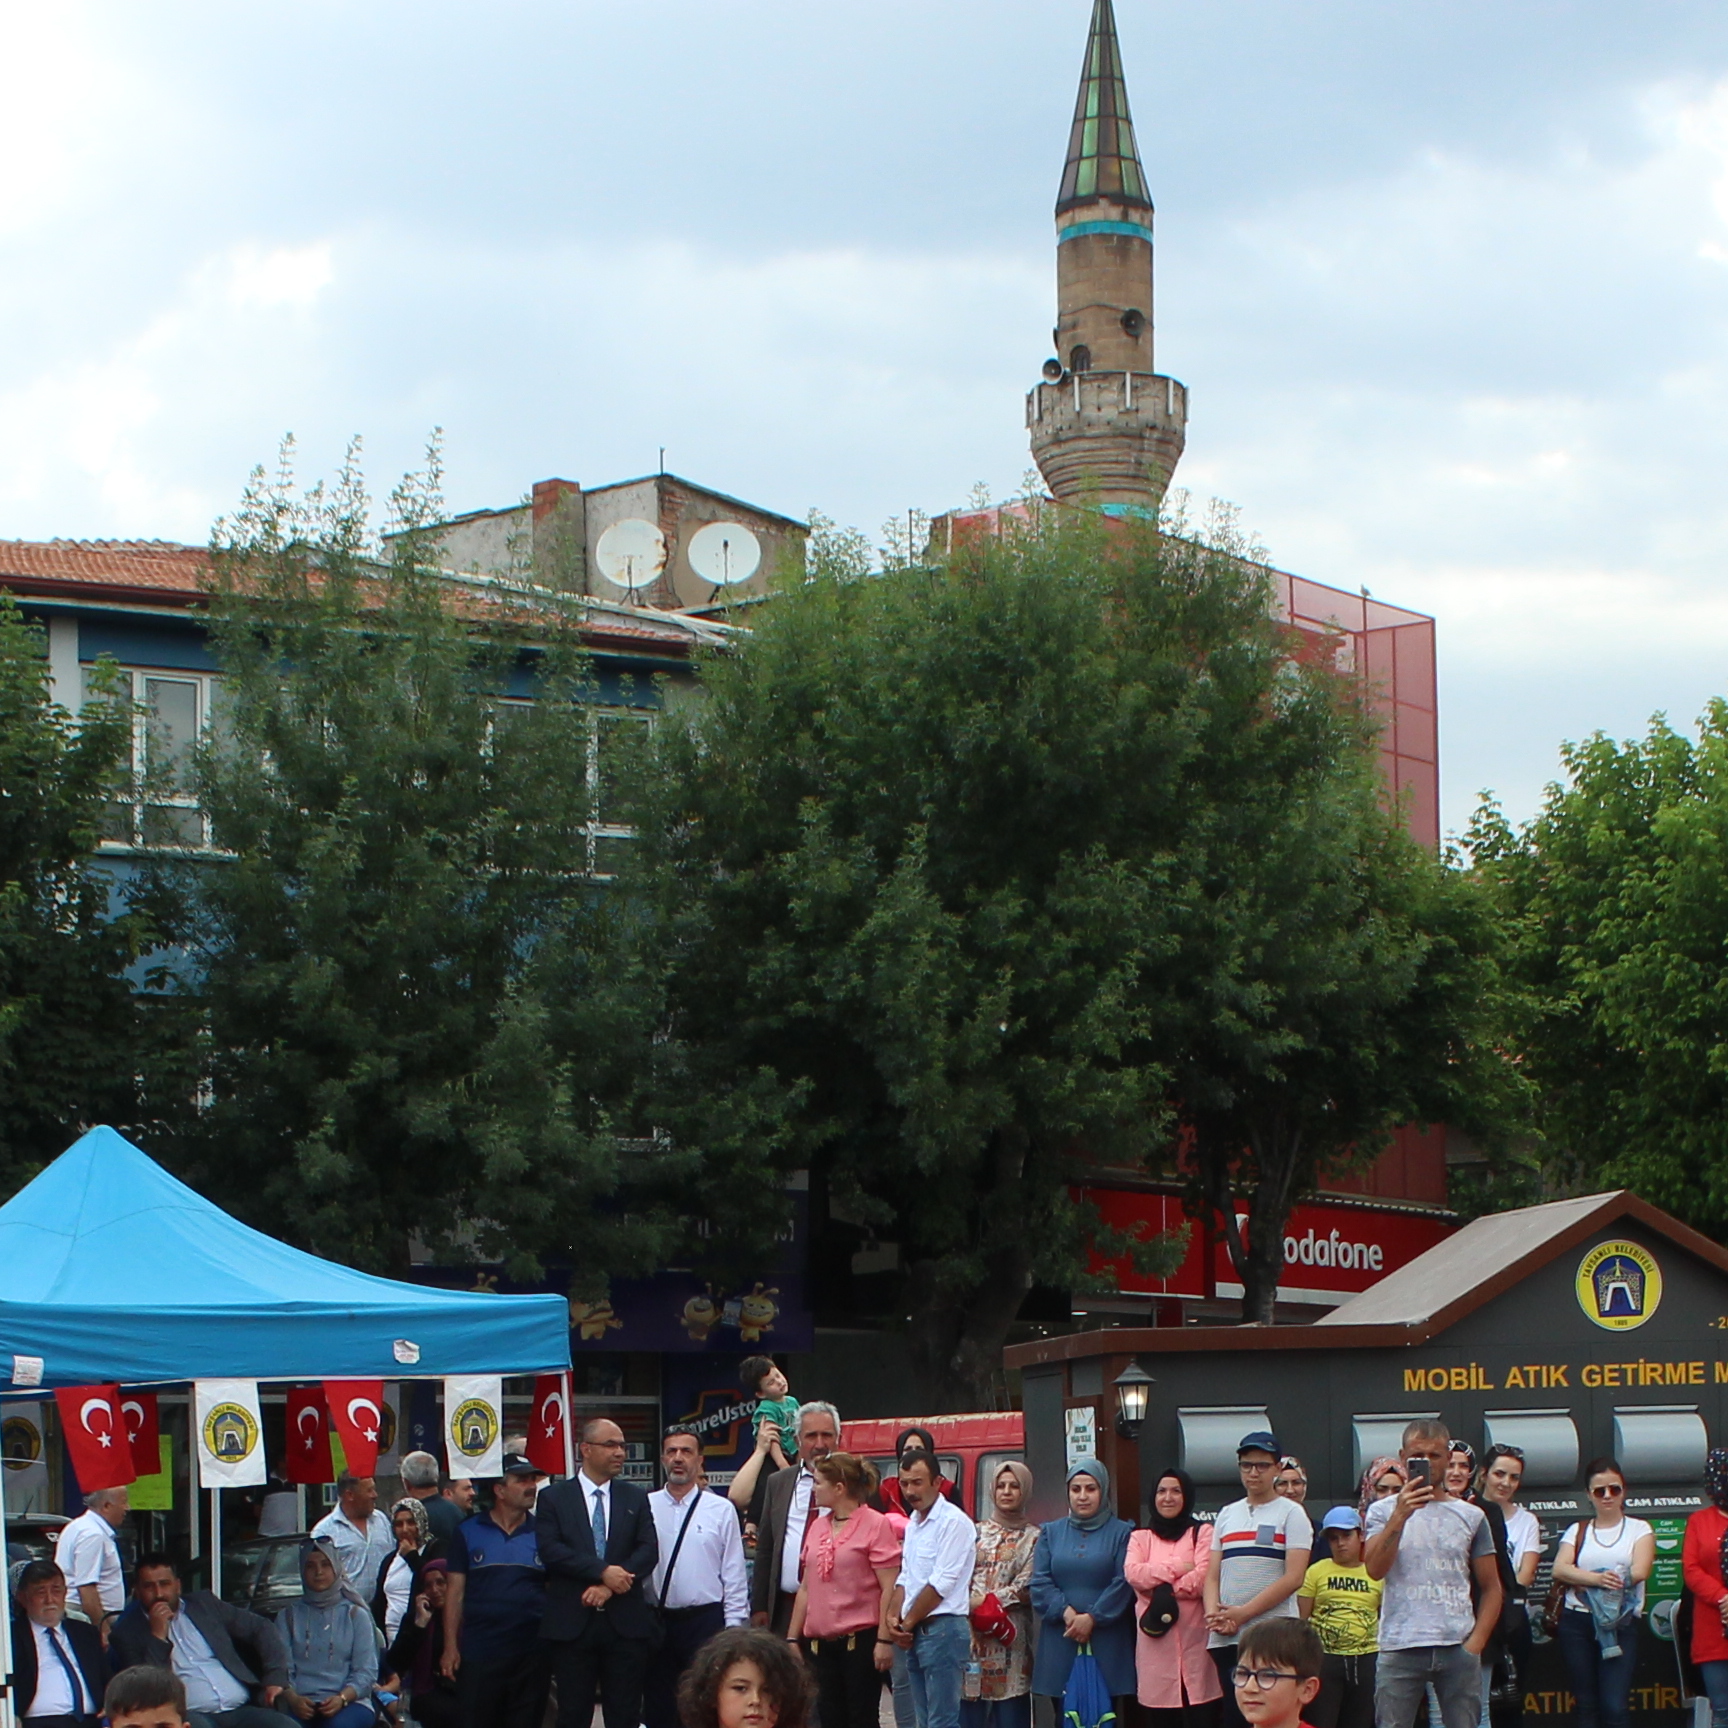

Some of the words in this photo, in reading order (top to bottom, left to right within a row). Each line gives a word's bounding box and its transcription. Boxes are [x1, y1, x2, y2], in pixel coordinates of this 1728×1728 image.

[1284, 1218, 1383, 1271] odafone
[1403, 1362, 1495, 1392] MOBİL
[1504, 1365, 1570, 1389] ATIK
[1581, 1358, 1706, 1388] GETİRME
[1529, 1500, 1577, 1510] ATIKLAR
[1625, 1498, 1650, 1507] CAM
[1653, 1496, 1701, 1506] ATIKLAR
[1192, 1511, 1218, 1521] AĞIT
[1327, 1576, 1369, 1594] MARVEL
